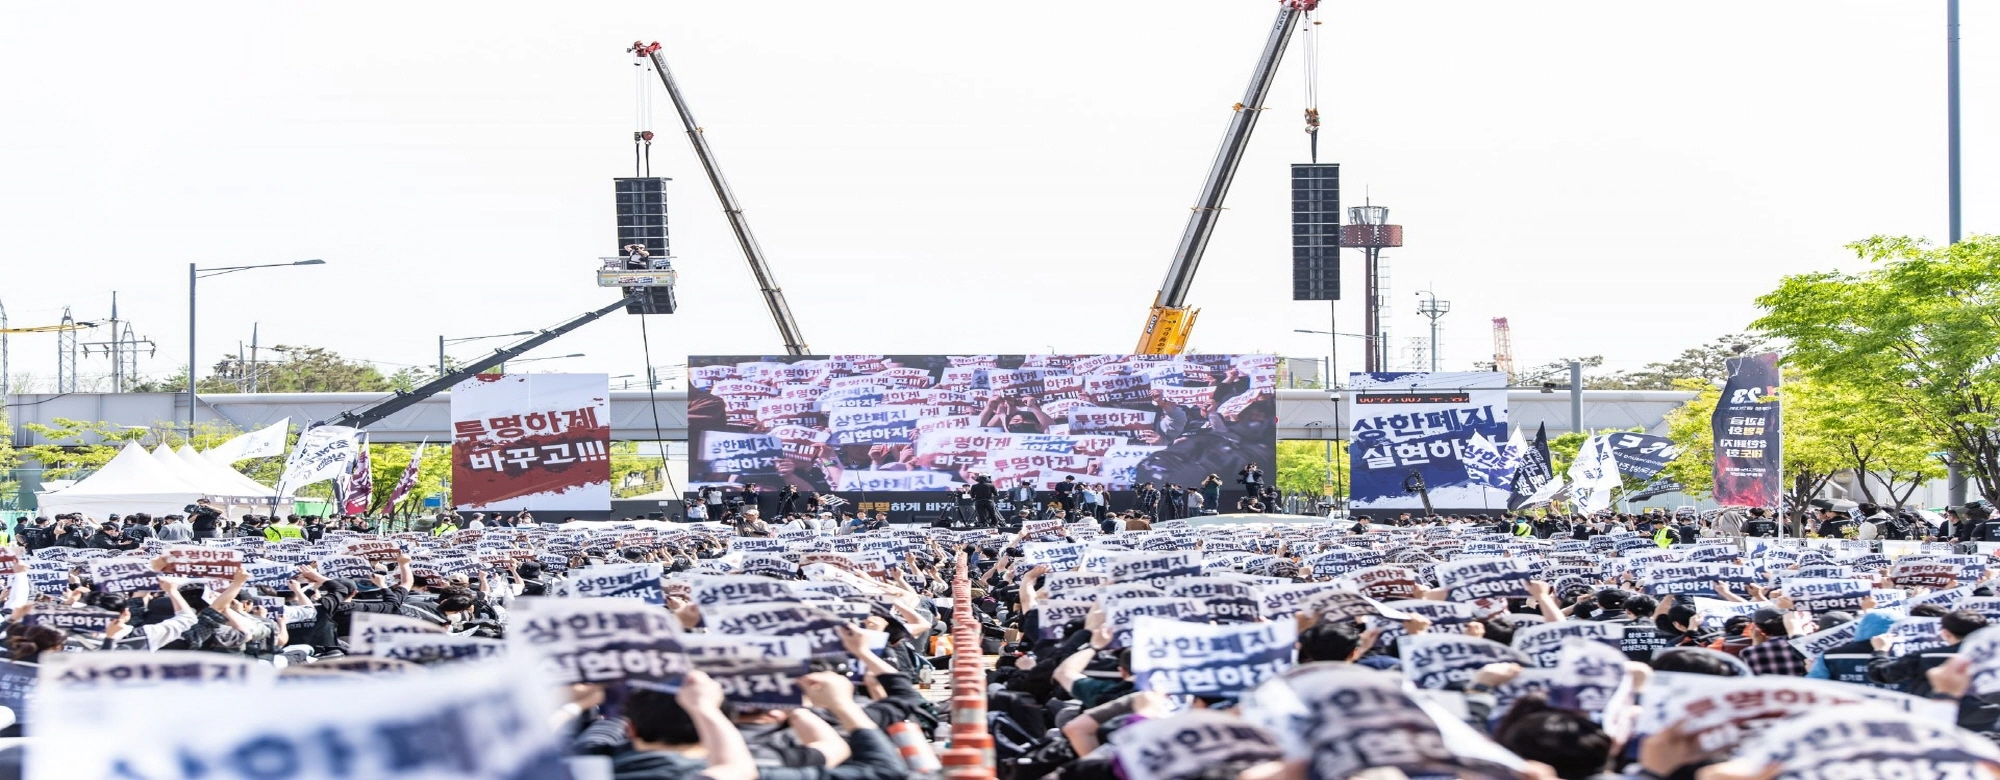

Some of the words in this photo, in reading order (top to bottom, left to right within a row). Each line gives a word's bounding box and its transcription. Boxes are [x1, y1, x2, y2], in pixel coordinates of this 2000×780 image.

[1276, 10, 1288, 30] KATO
[1147, 314, 1158, 334] KATO
[1076, 356, 1111, 370] 투명하게
[1185, 355, 1226, 363] 투명하게
[992, 372, 1037, 384] 투명하게
[1046, 377, 1073, 388] 하게
[1090, 374, 1142, 389] 투명하게
[718, 384, 771, 392] 투명하게
[994, 387, 1043, 398] 꾸고!!!
[1043, 391, 1079, 403] 꾸고!!!
[1096, 389, 1150, 403] 바꾸고!!!
[762, 402, 813, 414] 투명하게
[455, 406, 600, 443] 투명하게
[835, 410, 906, 426] 상한폐지
[1075, 411, 1145, 424] 투명하게
[1352, 405, 1498, 441] 상한폐지
[922, 418, 970, 433] 명하게
[838, 428, 912, 443] 실현하자
[711, 437, 774, 453] 상한폐지
[782, 441, 814, 454] 고!!!
[937, 436, 1011, 450] 투명하게
[1085, 438, 1115, 449] 하게
[470, 440, 607, 471] 바꾸고!!!
[1362, 435, 1507, 469] 실현하
[994, 456, 1074, 471] 투명하게
[858, 502, 920, 511] 투명하게
[778, 531, 813, 539] 상한폐지
[348, 541, 393, 552] 투명하게
[732, 540, 778, 549] 상한폐지
[863, 541, 903, 551] 상한폐지
[1616, 540, 1642, 549] 상한폐지
[170, 550, 234, 559] 투명하게
[269, 554, 309, 564] 상한폐지
[1629, 554, 1674, 567] 상한폐지
[1686, 547, 1728, 560] 한폐지
[175, 564, 237, 576] 바꾸고!!!
[322, 558, 367, 569] 상한폐지
[743, 559, 791, 570] 상한폐지
[1111, 555, 1188, 576] 상한폐지
[1314, 564, 1360, 573] 실현하자
[1353, 569, 1406, 583] 명하게
[1443, 561, 1517, 584] 상한폐지
[1545, 568, 1593, 577] 상한폐지
[1652, 566, 1710, 579] 상한폐지
[576, 569, 649, 592] 상한폐지
[1049, 577, 1107, 591] 상한폐
[1361, 584, 1413, 596] 꾸고!!!
[1451, 578, 1527, 601] 실현하자
[1788, 581, 1859, 597] 상한폐지
[1205, 602, 1259, 618] 하자
[1794, 598, 1860, 610] 실현하자
[1046, 605, 1090, 620] 상한
[1113, 600, 1197, 624] 상한폐지
[35, 613, 113, 631] 실현하자
[1521, 621, 1607, 652] 상한폐지
[1892, 623, 1942, 637] 상한폐
[1147, 627, 1275, 659] 상한폐지
[1410, 643, 1513, 670] 상한폐
[1149, 658, 1290, 691] 실현하자
[1422, 669, 1477, 690] 실현
[1140, 727, 1278, 770] 상한폐
